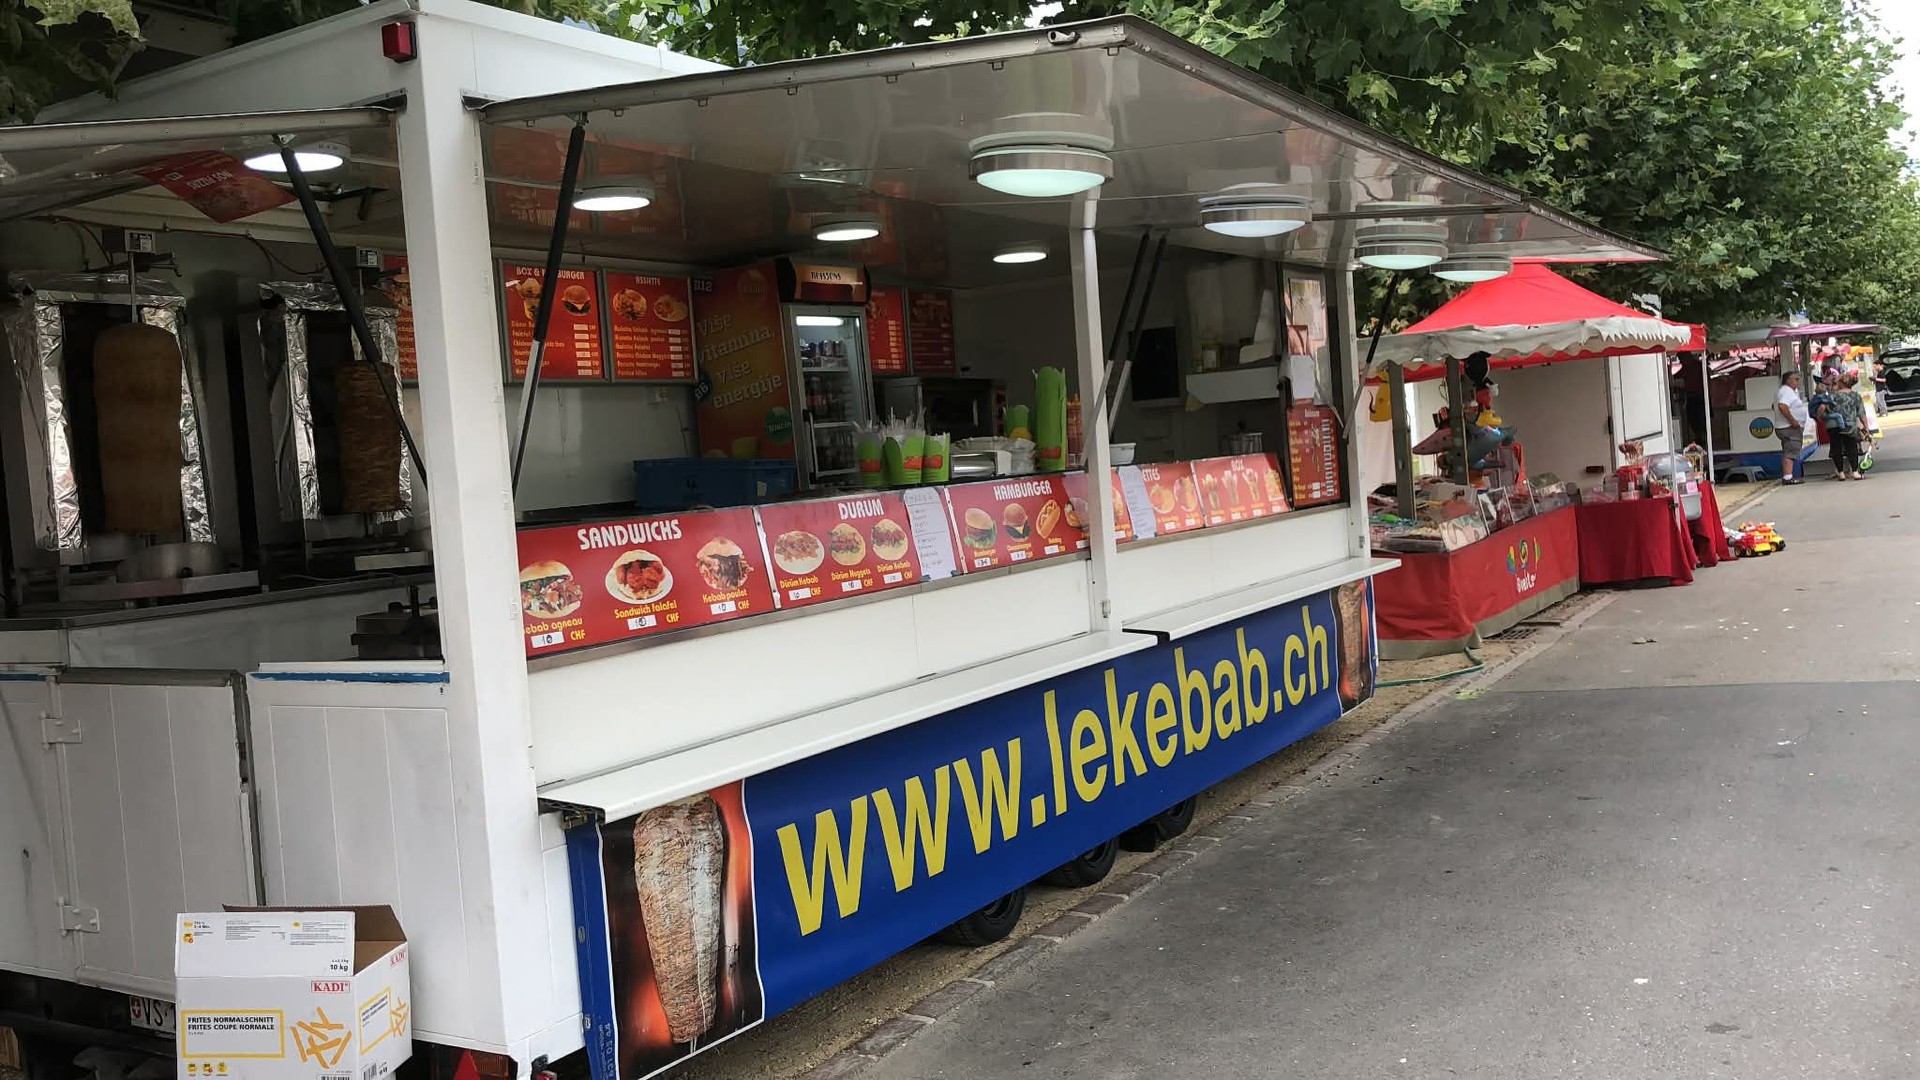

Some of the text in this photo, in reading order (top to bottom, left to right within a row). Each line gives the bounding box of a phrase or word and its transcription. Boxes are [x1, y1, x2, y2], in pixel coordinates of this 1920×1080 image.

[516, 266, 532, 276] BOX
[534, 269, 540, 277] &
[1142, 468, 1161, 482] ETTES
[993, 480, 1053, 501] HAMBURGER
[838, 498, 885, 520] DURUM
[577, 519, 683, 551] SANDWICHS
[831, 570, 849, 580] Dürüm
[780, 575, 819, 589] Dürüm Kebab
[702, 588, 748, 603] Kebab poulet
[810, 587, 821, 597] CHF
[737, 599, 750, 610] CHF
[614, 605, 651, 619] Sandwich
[665, 612, 680, 623] CHF
[524, 617, 583, 634] ebab agneau
[570, 629, 586, 640] CHF
[776, 605, 1331, 937] www.lekebab.ch
[339, 963, 349, 972] kg
[187, 1016, 274, 1024] FRITES NORMALSCHNITT
[239, 1023, 275, 1031] NORMALE
